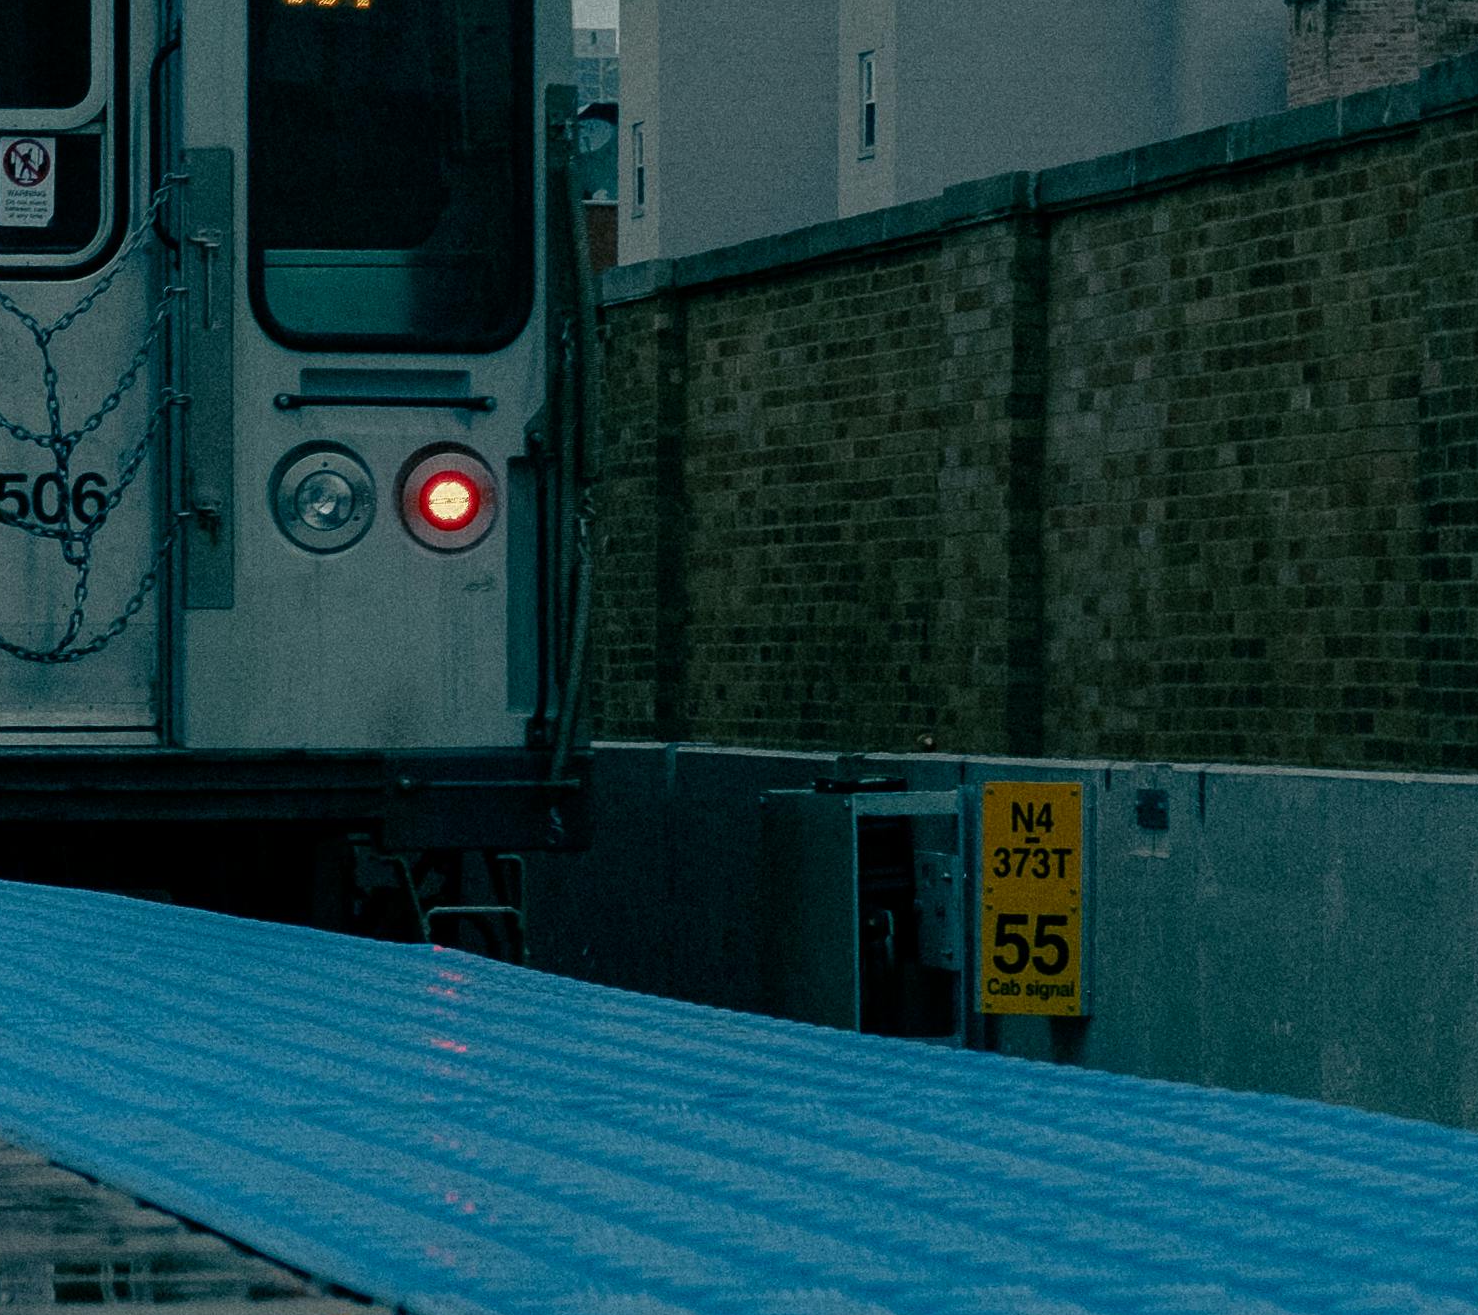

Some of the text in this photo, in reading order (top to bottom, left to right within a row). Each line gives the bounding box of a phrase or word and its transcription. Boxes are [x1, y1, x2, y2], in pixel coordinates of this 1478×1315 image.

[1011, 801, 1054, 833] N4
[992, 847, 1072, 879] 373T
[992, 913, 1070, 976] 55
[987, 977, 1075, 1000] Cab signal
